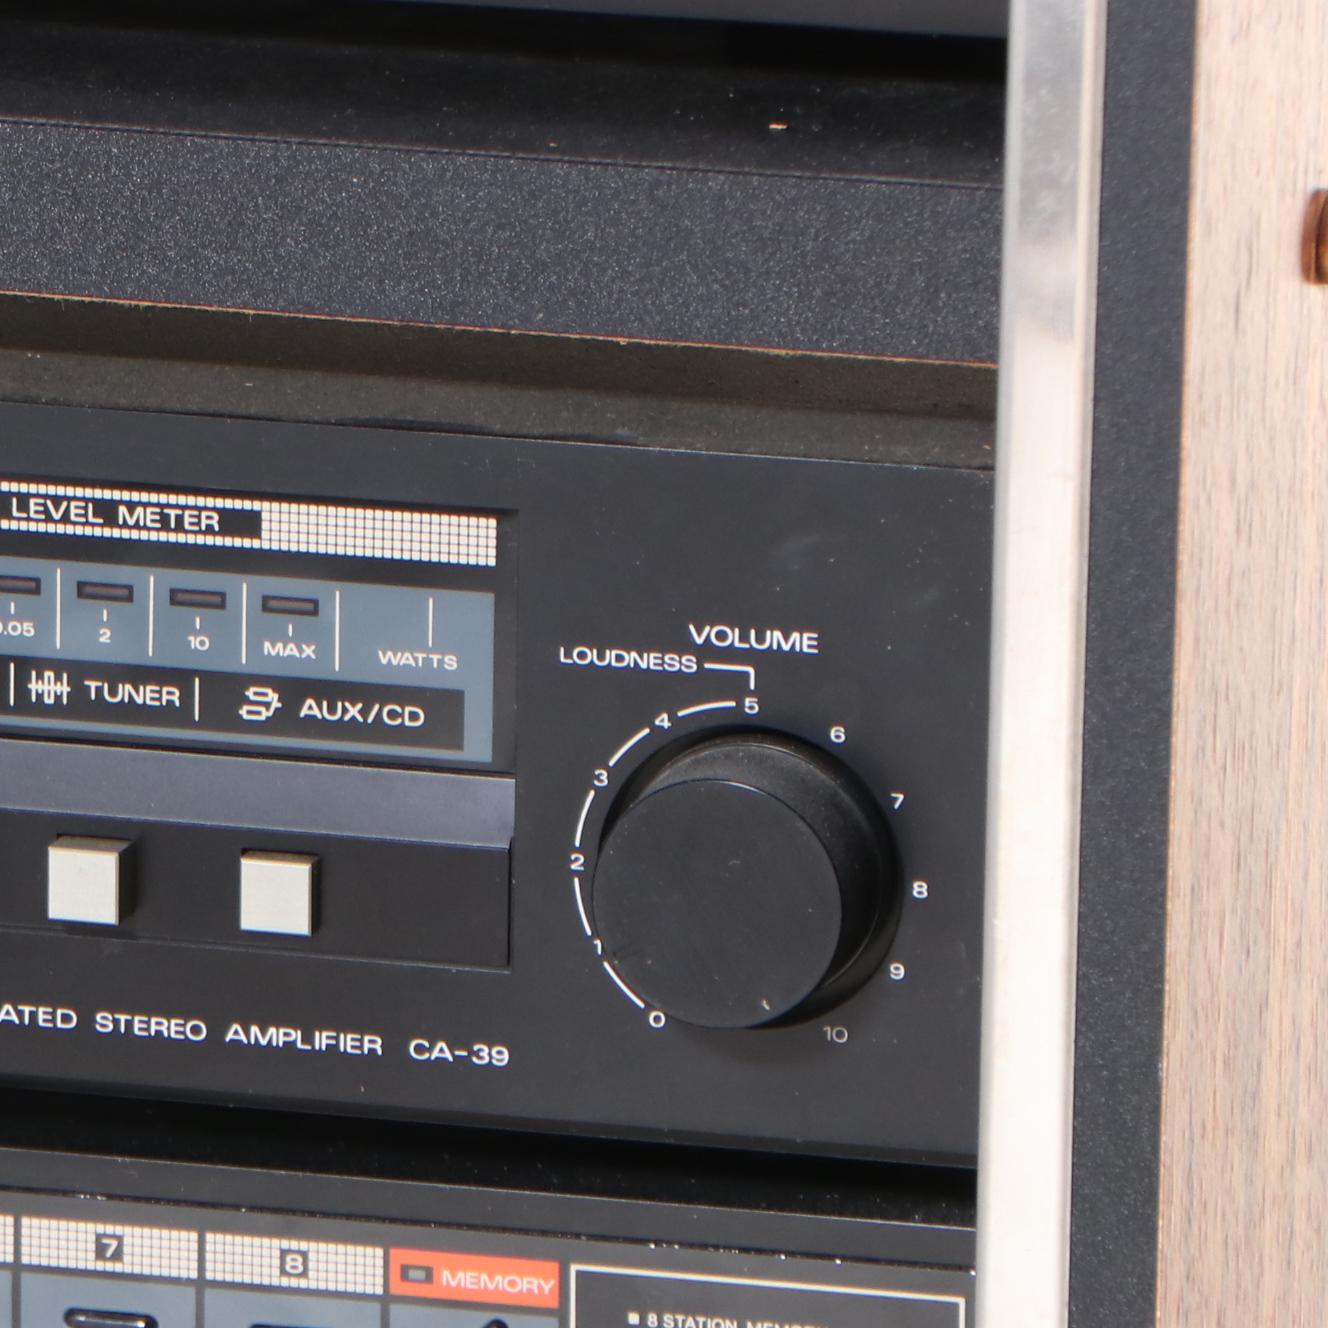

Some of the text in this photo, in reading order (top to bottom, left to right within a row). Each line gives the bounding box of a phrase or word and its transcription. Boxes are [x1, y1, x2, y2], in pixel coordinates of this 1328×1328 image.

[12, 498, 104, 525] LEVEL
[117, 505, 220, 532] METER
[99, 628, 111, 643] 2
[187, 635, 209, 651] 10
[689, 624, 819, 653] VOLUME
[264, 640, 316, 659] MAX
[378, 650, 457, 670] WATTS
[559, 647, 697, 673] LOUDNESS
[84, 681, 180, 707] TUNER
[300, 699, 425, 727] AUX/CD
[96, 1012, 207, 1042] STEREO
[225, 1024, 383, 1056] AMPLIFIER
[409, 1040, 509, 1067] CA-39
[102, 1241, 119, 1259] 7
[285, 1256, 303, 1274] 8
[441, 1269, 555, 1295] MEMORY
[647, 1313, 658, 1328] 8
